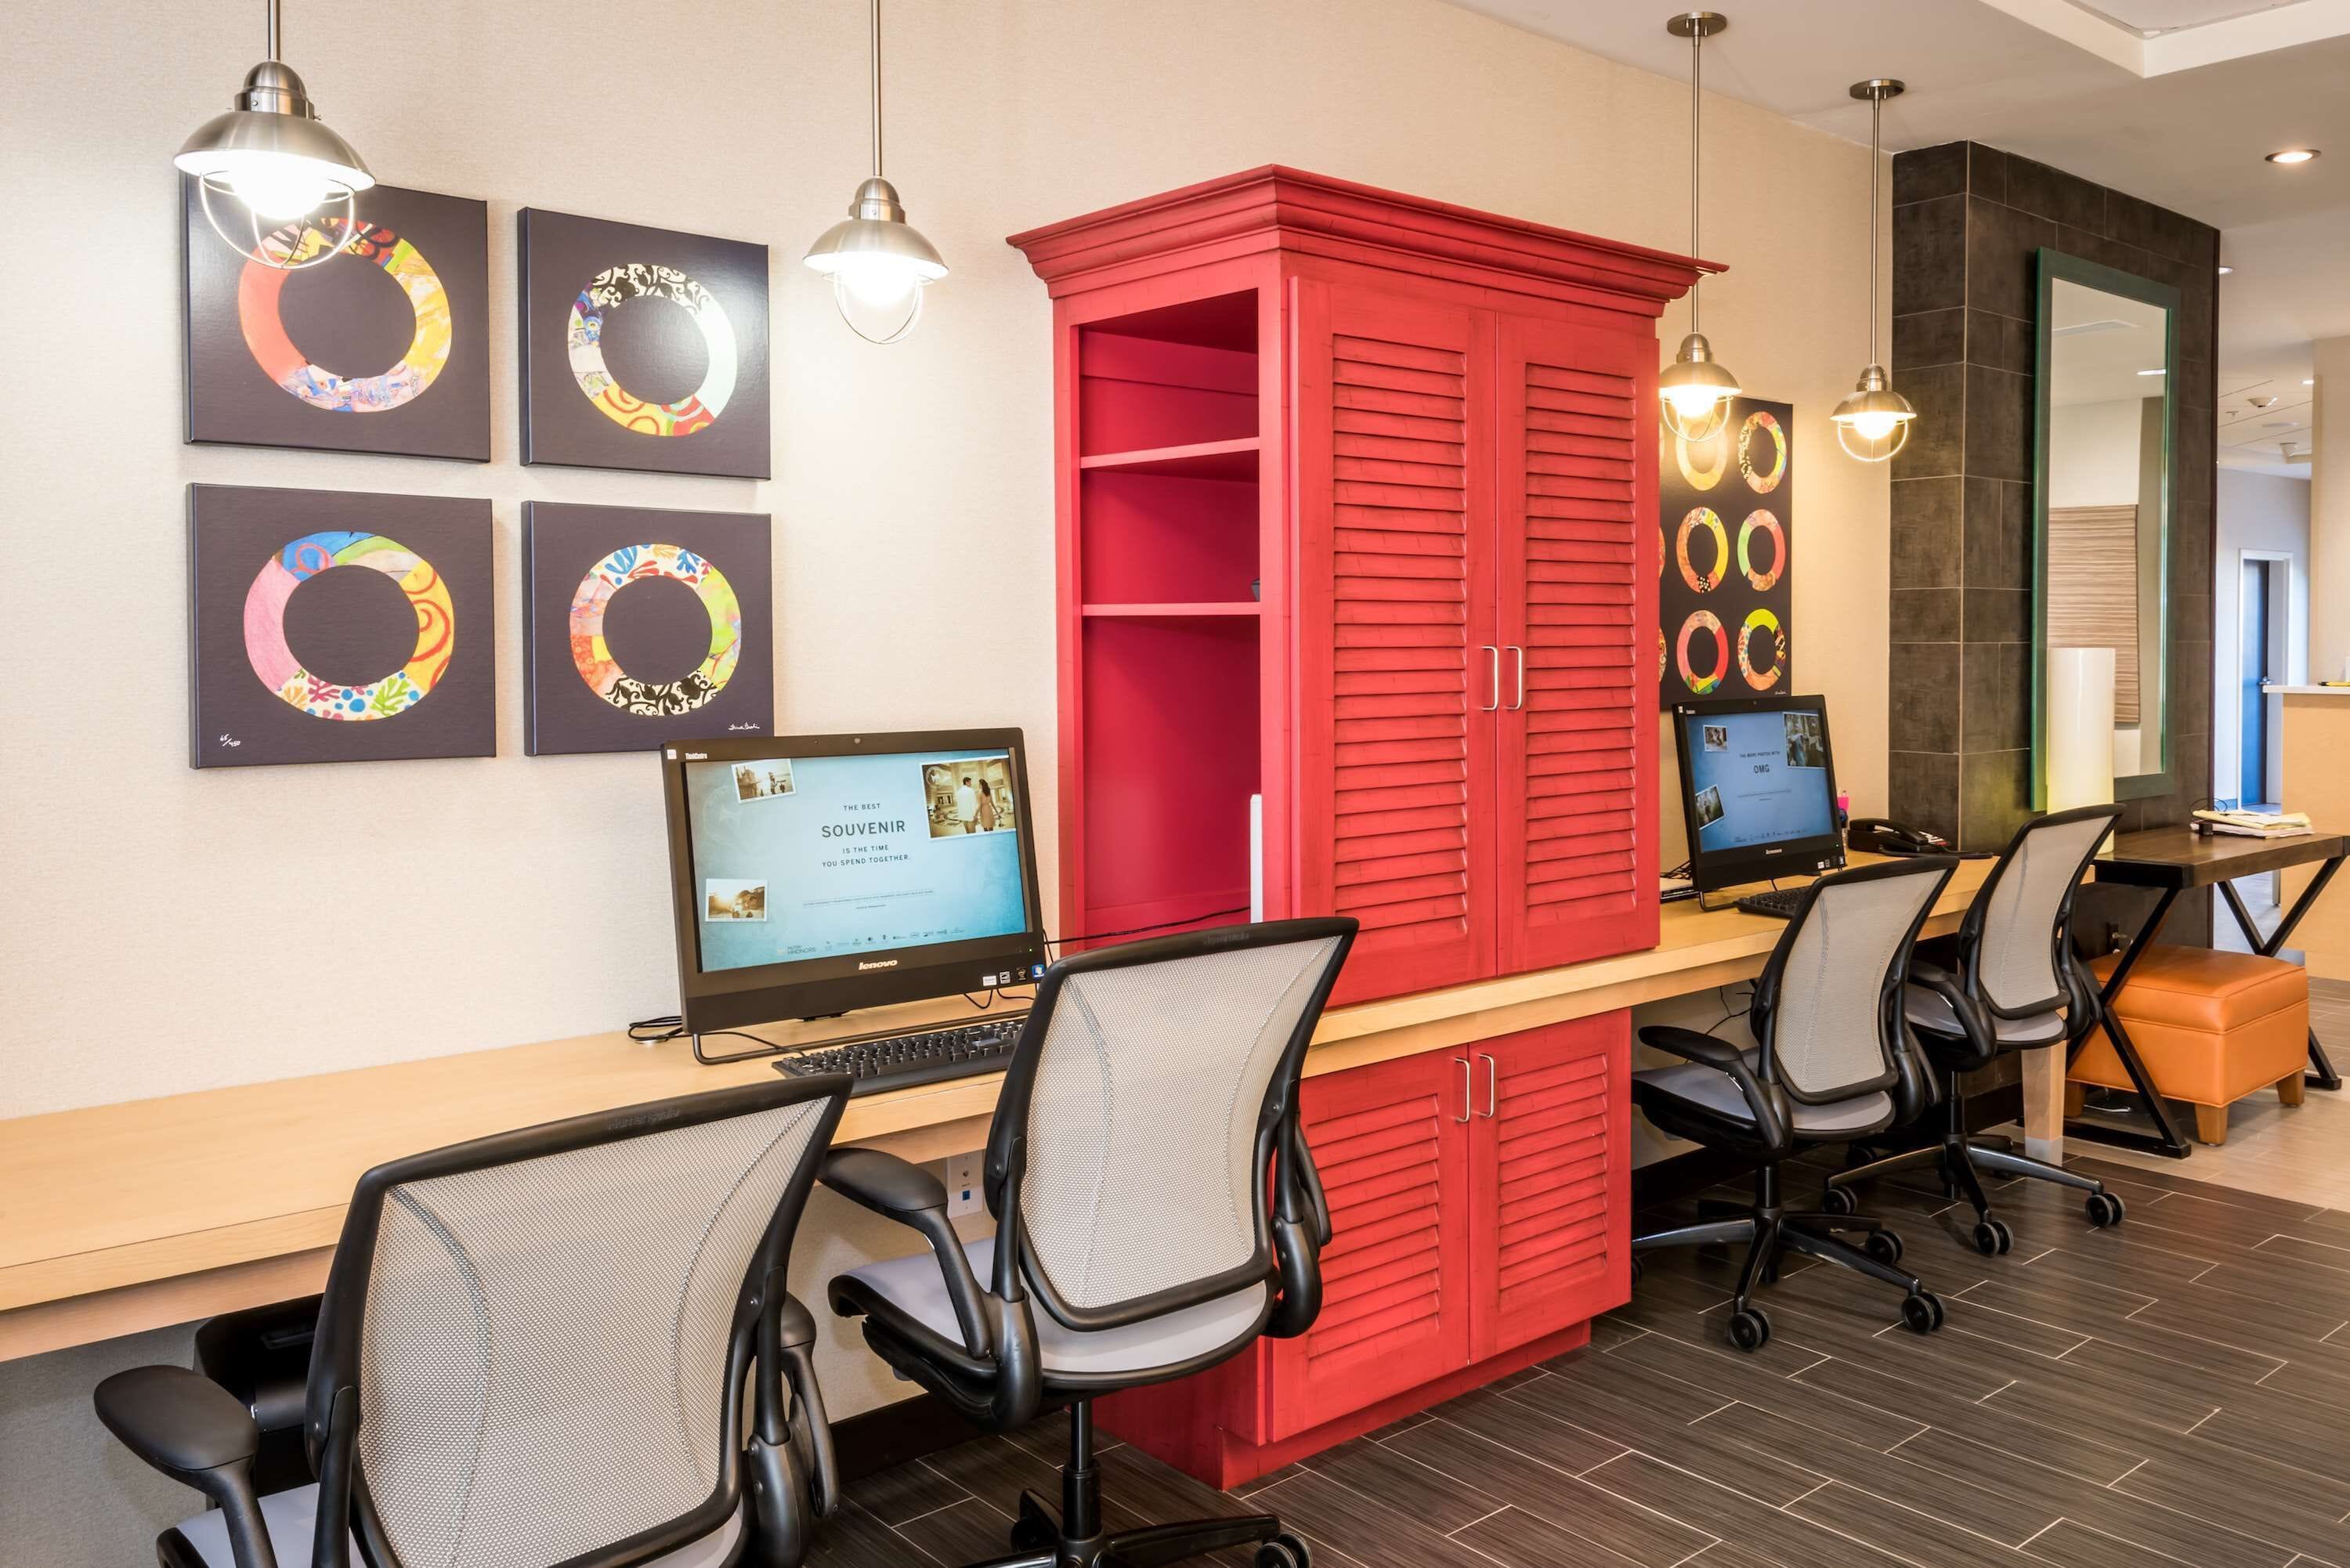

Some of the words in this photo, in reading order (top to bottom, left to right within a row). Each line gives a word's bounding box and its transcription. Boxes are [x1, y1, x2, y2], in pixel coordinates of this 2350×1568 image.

[1754, 764, 1770, 774] OMG
[821, 820, 906, 838] SOUVENIR
[841, 858, 866, 866] SPEND
